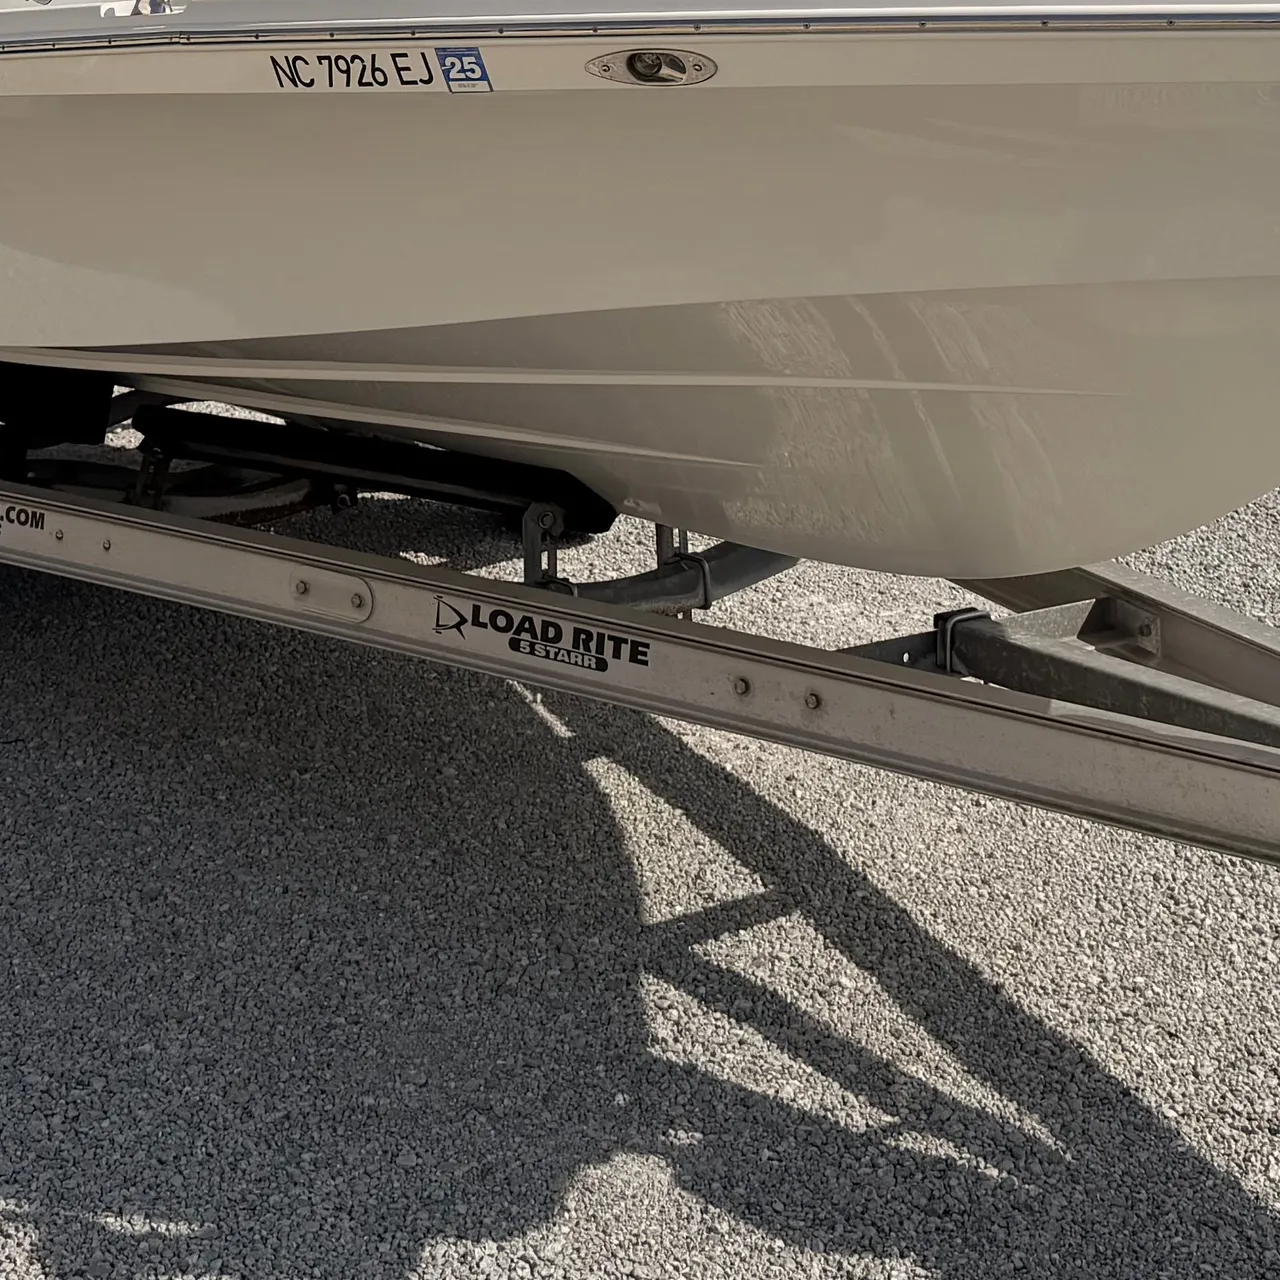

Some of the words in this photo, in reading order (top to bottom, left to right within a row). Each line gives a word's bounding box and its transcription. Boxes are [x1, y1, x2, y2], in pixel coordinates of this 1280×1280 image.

[269, 54, 315, 88] NC
[316, 52, 389, 88] 7926
[389, 51, 434, 86] EJ
[445, 56, 483, 80] 25
[471, 603, 564, 645] LOAD
[571, 626, 651, 667] RITE
[519, 639, 531, 654] 5
[533, 643, 597, 669] STARR
